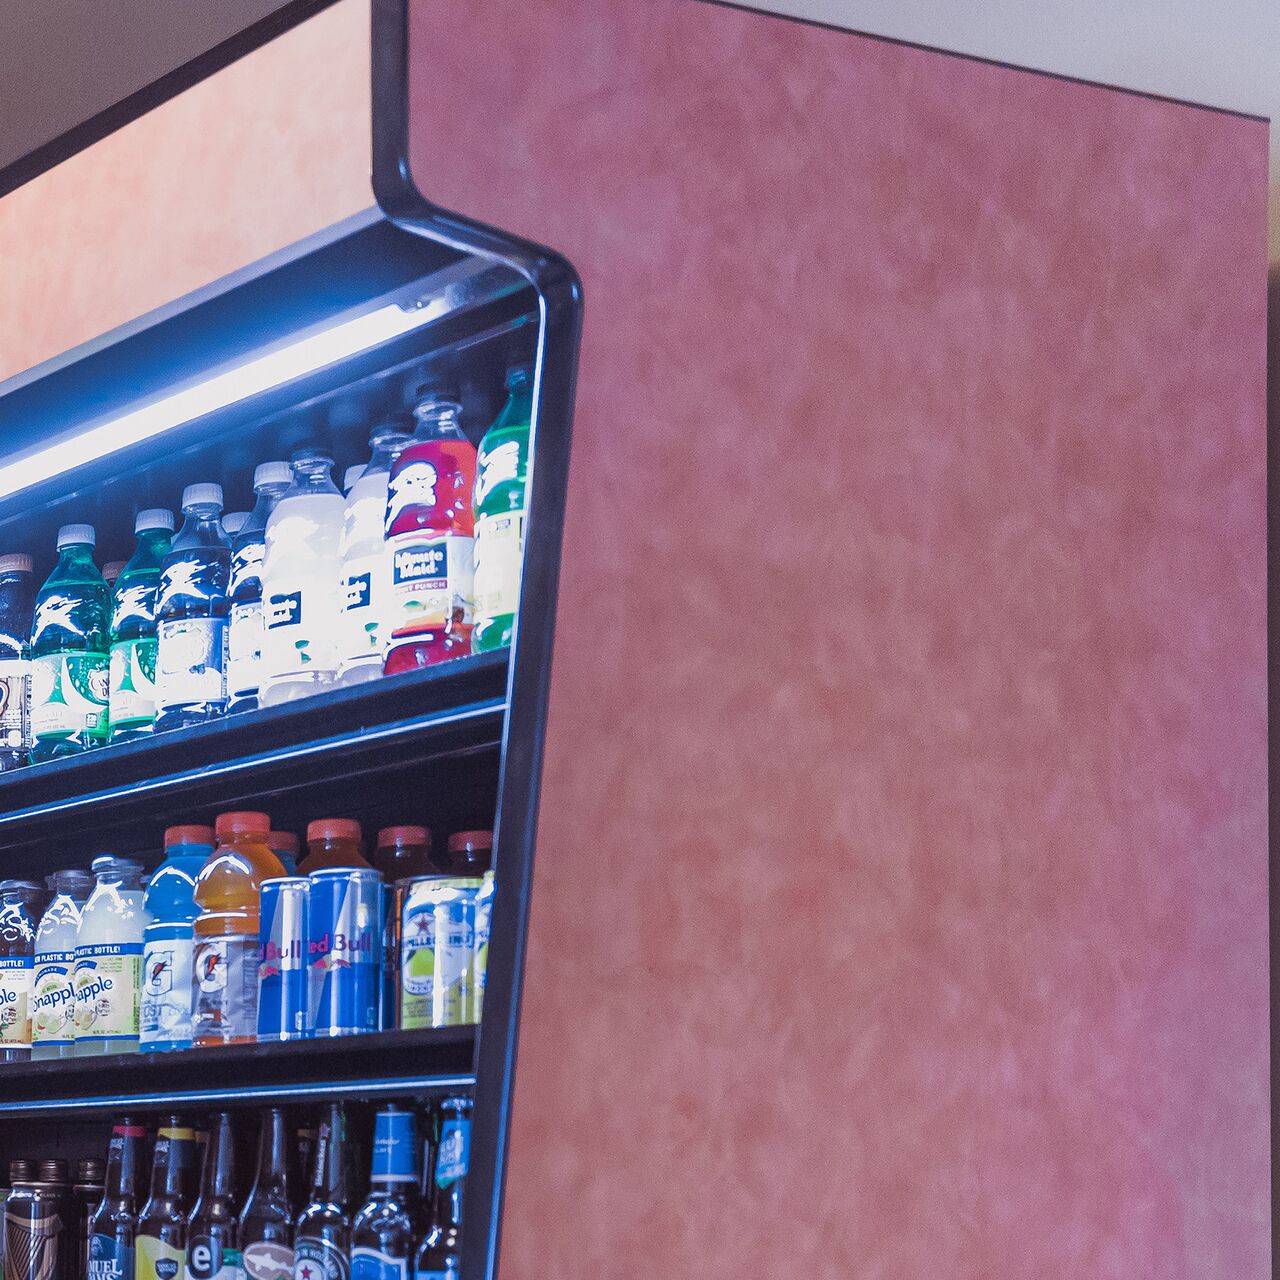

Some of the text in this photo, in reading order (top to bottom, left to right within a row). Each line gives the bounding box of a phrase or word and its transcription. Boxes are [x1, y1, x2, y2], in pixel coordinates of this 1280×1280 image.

[395, 548, 444, 569] Minute
[400, 560, 437, 579] Maid
[414, 581, 446, 591] PUNCH
[95, 945, 121, 954] BOTTLE!
[333, 933, 371, 951] Bull
[0, 959, 25, 968] BOTTLE!
[41, 954, 64, 963] PLASTIC
[196, 942, 228, 993] G
[146, 950, 174, 997] G
